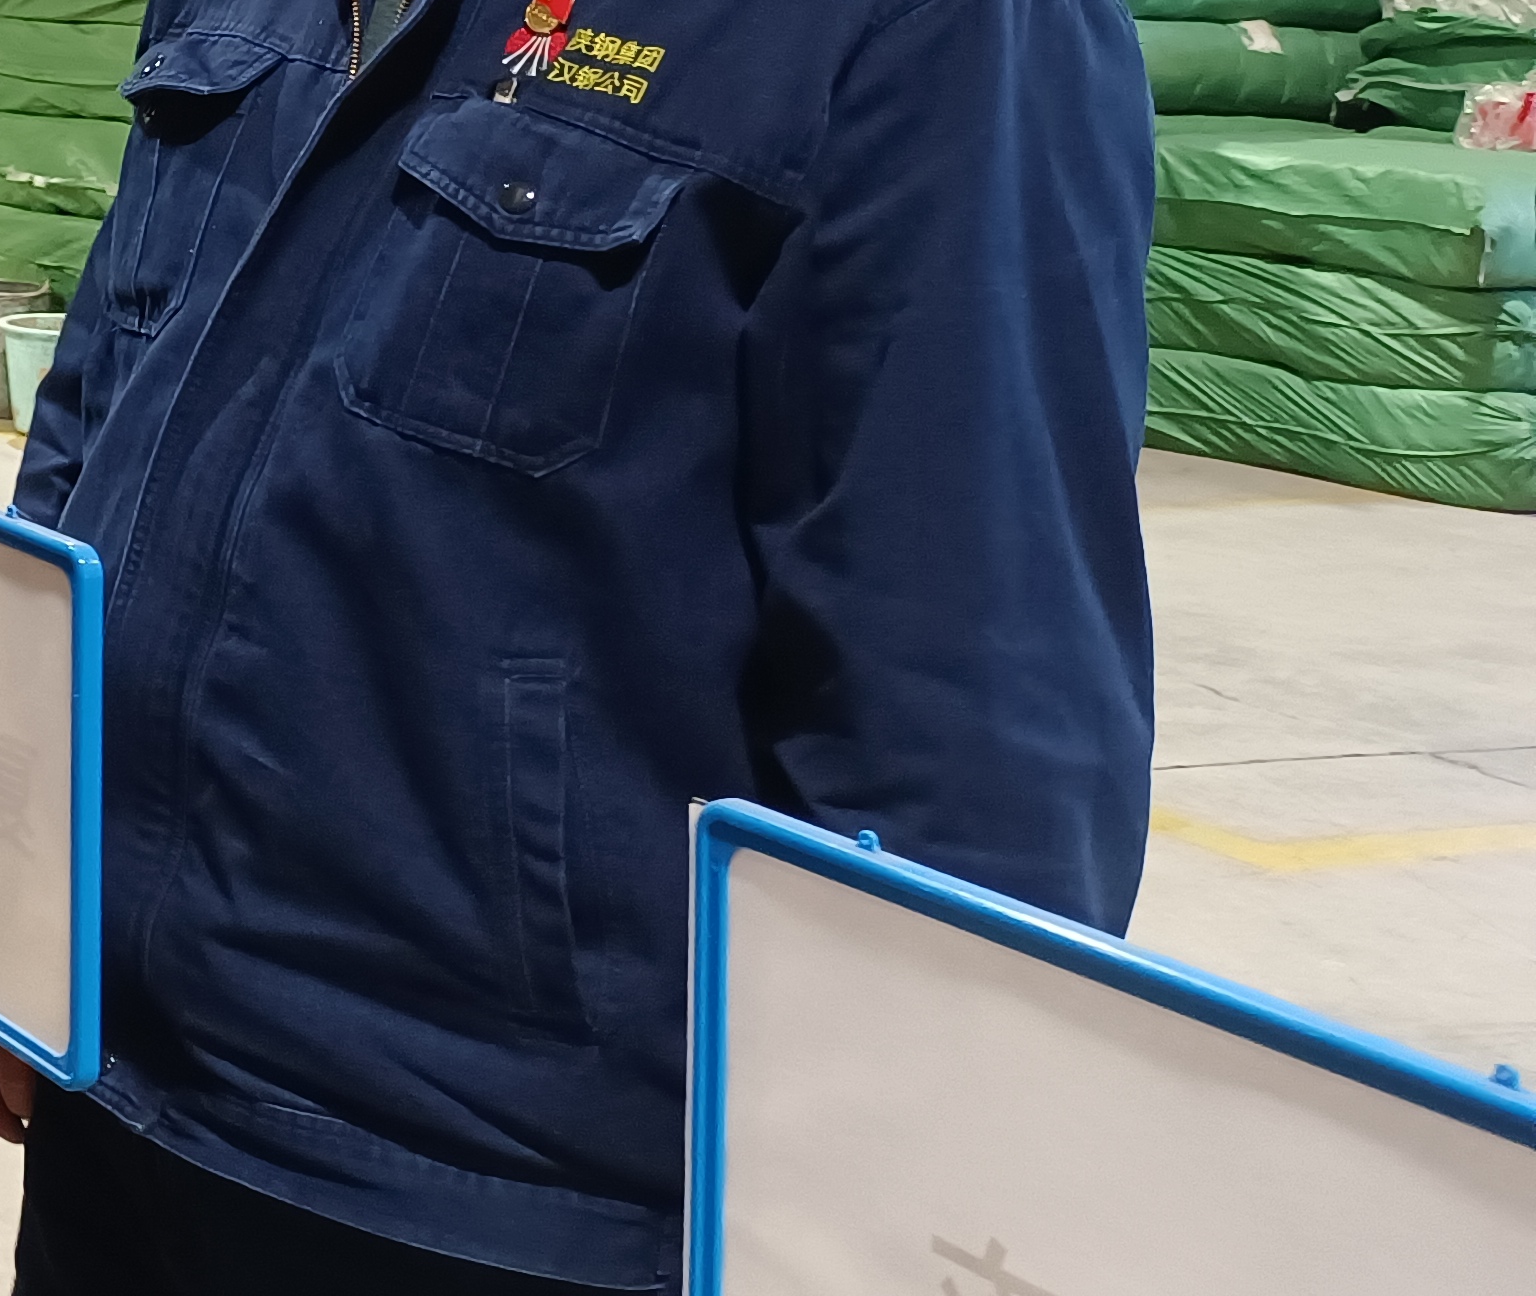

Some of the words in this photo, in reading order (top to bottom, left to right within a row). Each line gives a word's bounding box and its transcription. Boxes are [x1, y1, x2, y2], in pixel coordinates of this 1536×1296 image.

[565, 28, 666, 73] 陕钢集团
[547, 56, 649, 104] 汉钢公司
